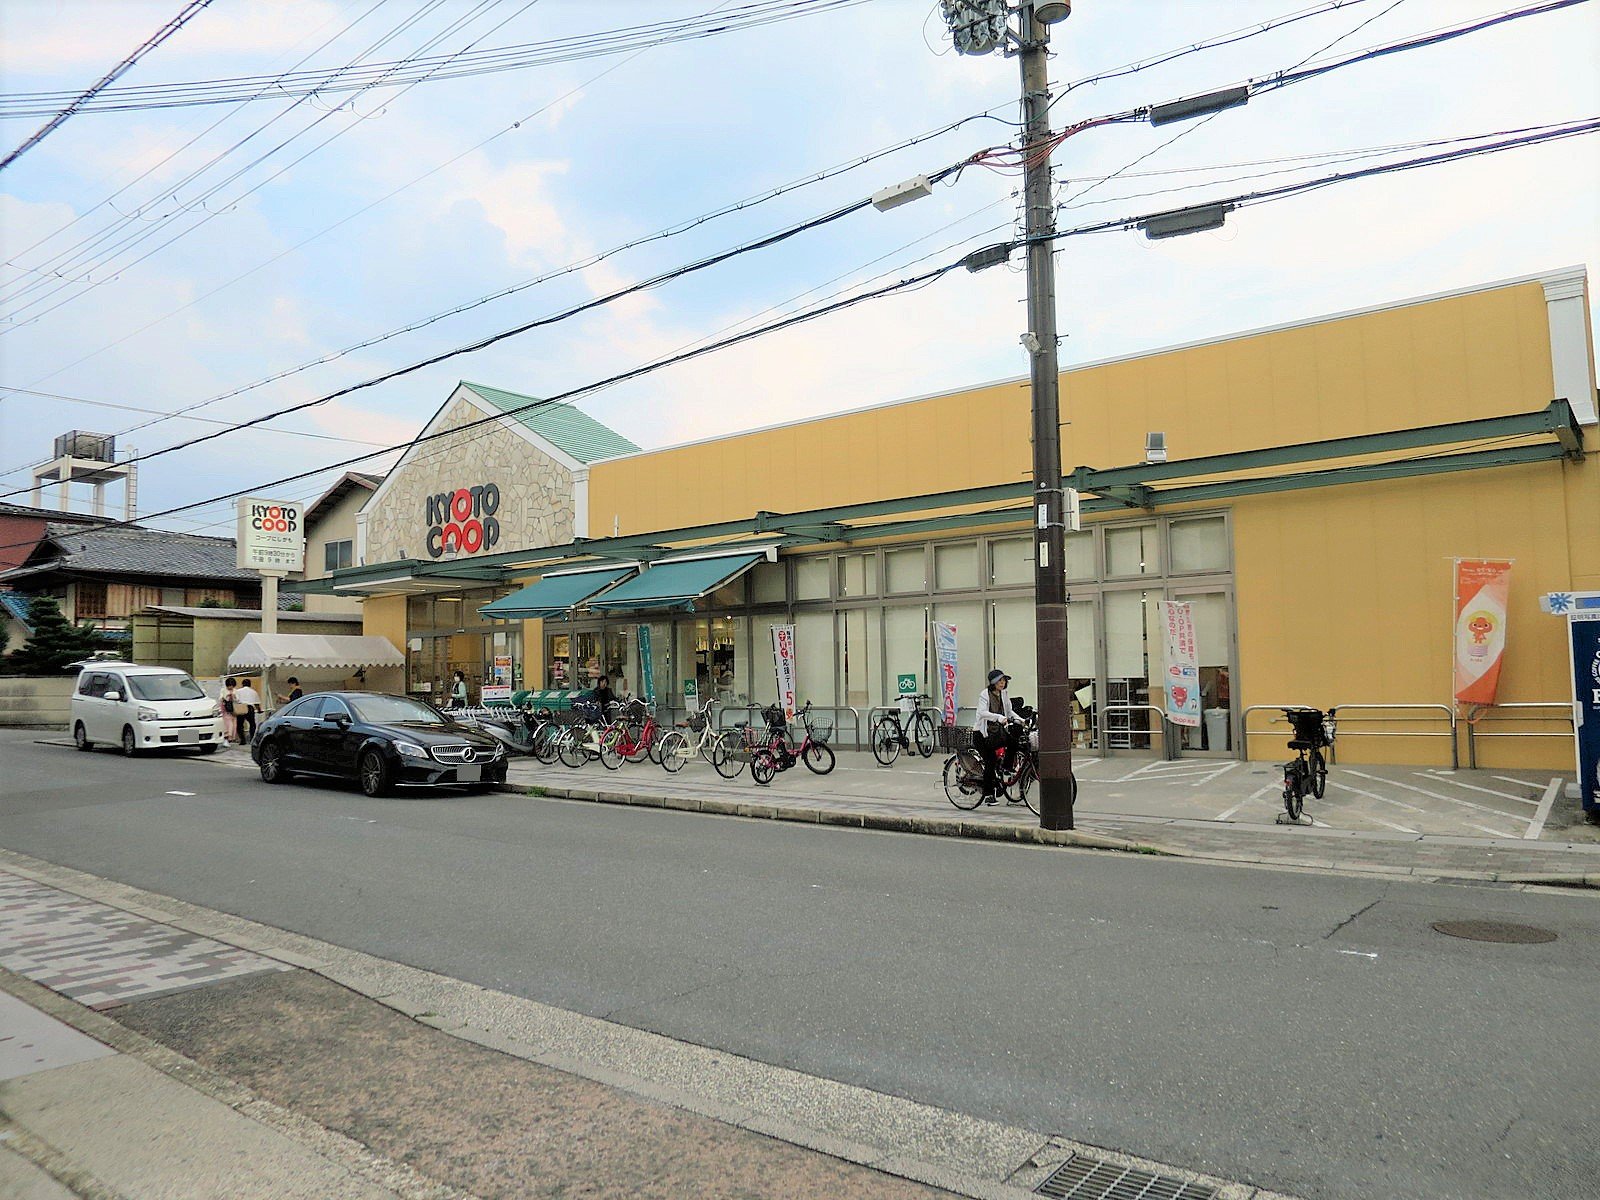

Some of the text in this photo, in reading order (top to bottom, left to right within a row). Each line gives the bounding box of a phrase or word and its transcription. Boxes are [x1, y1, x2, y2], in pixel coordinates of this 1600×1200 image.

[252, 504, 297, 520] KYOTO
[427, 483, 499, 527] KYOTO
[252, 517, 297, 532] COOP
[427, 517, 499, 558] COOP
